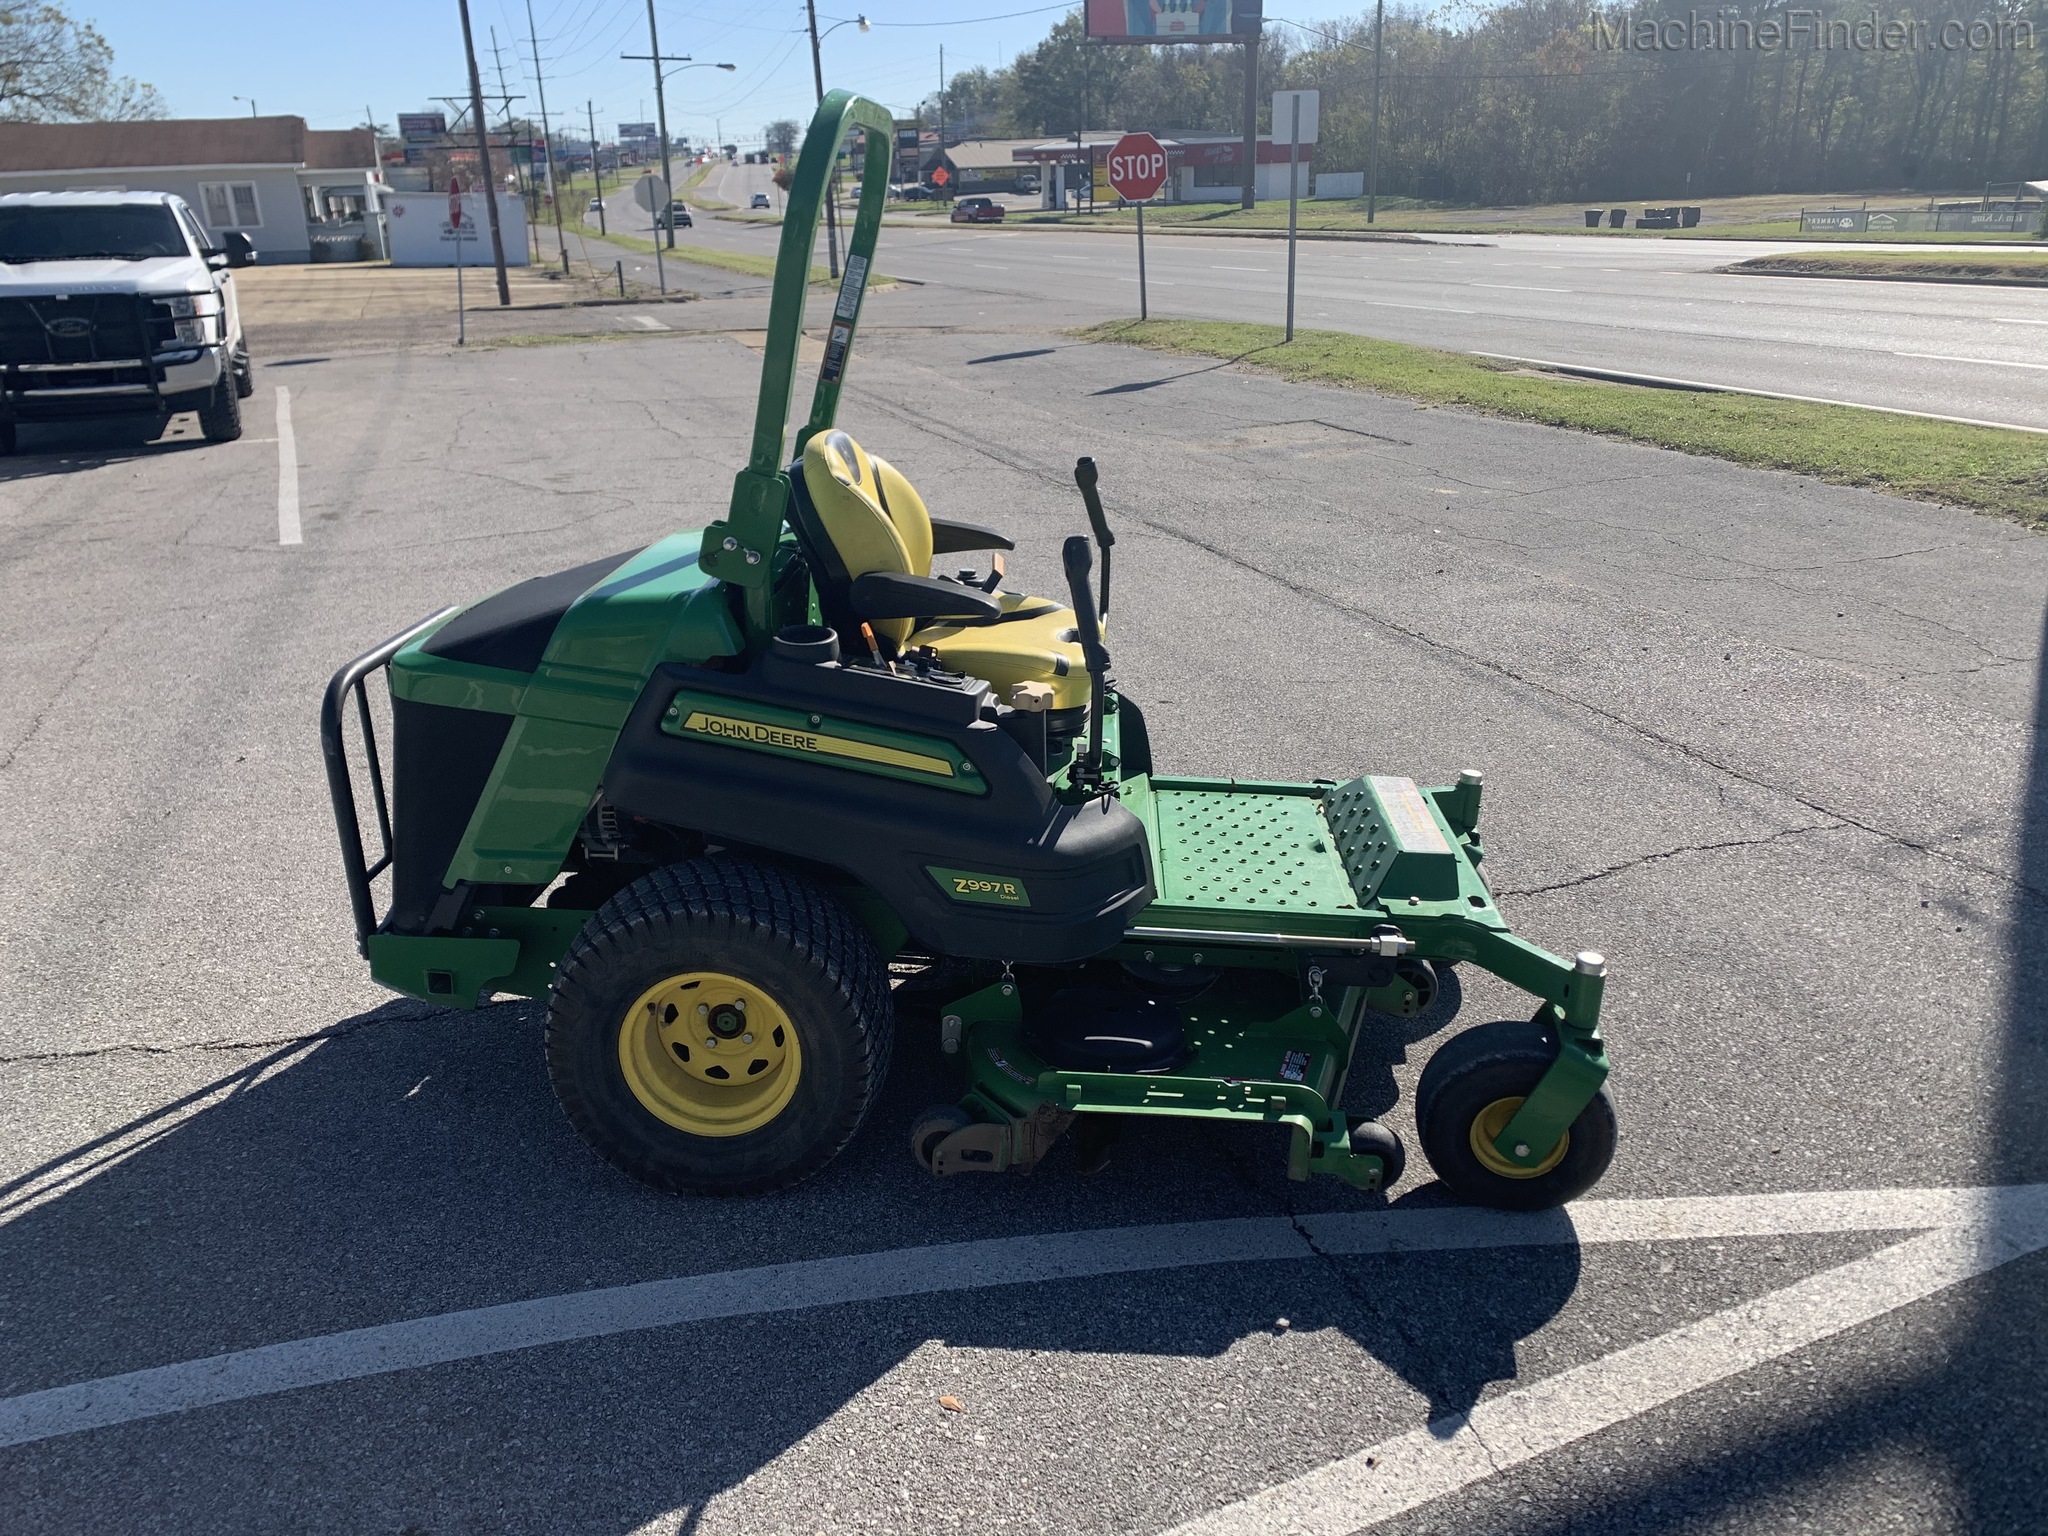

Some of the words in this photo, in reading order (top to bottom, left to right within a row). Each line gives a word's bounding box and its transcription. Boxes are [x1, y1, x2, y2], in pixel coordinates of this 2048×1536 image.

[1112, 153, 1164, 181] STOP
[698, 717, 750, 739] JOHN
[755, 726, 818, 750] DEERE
